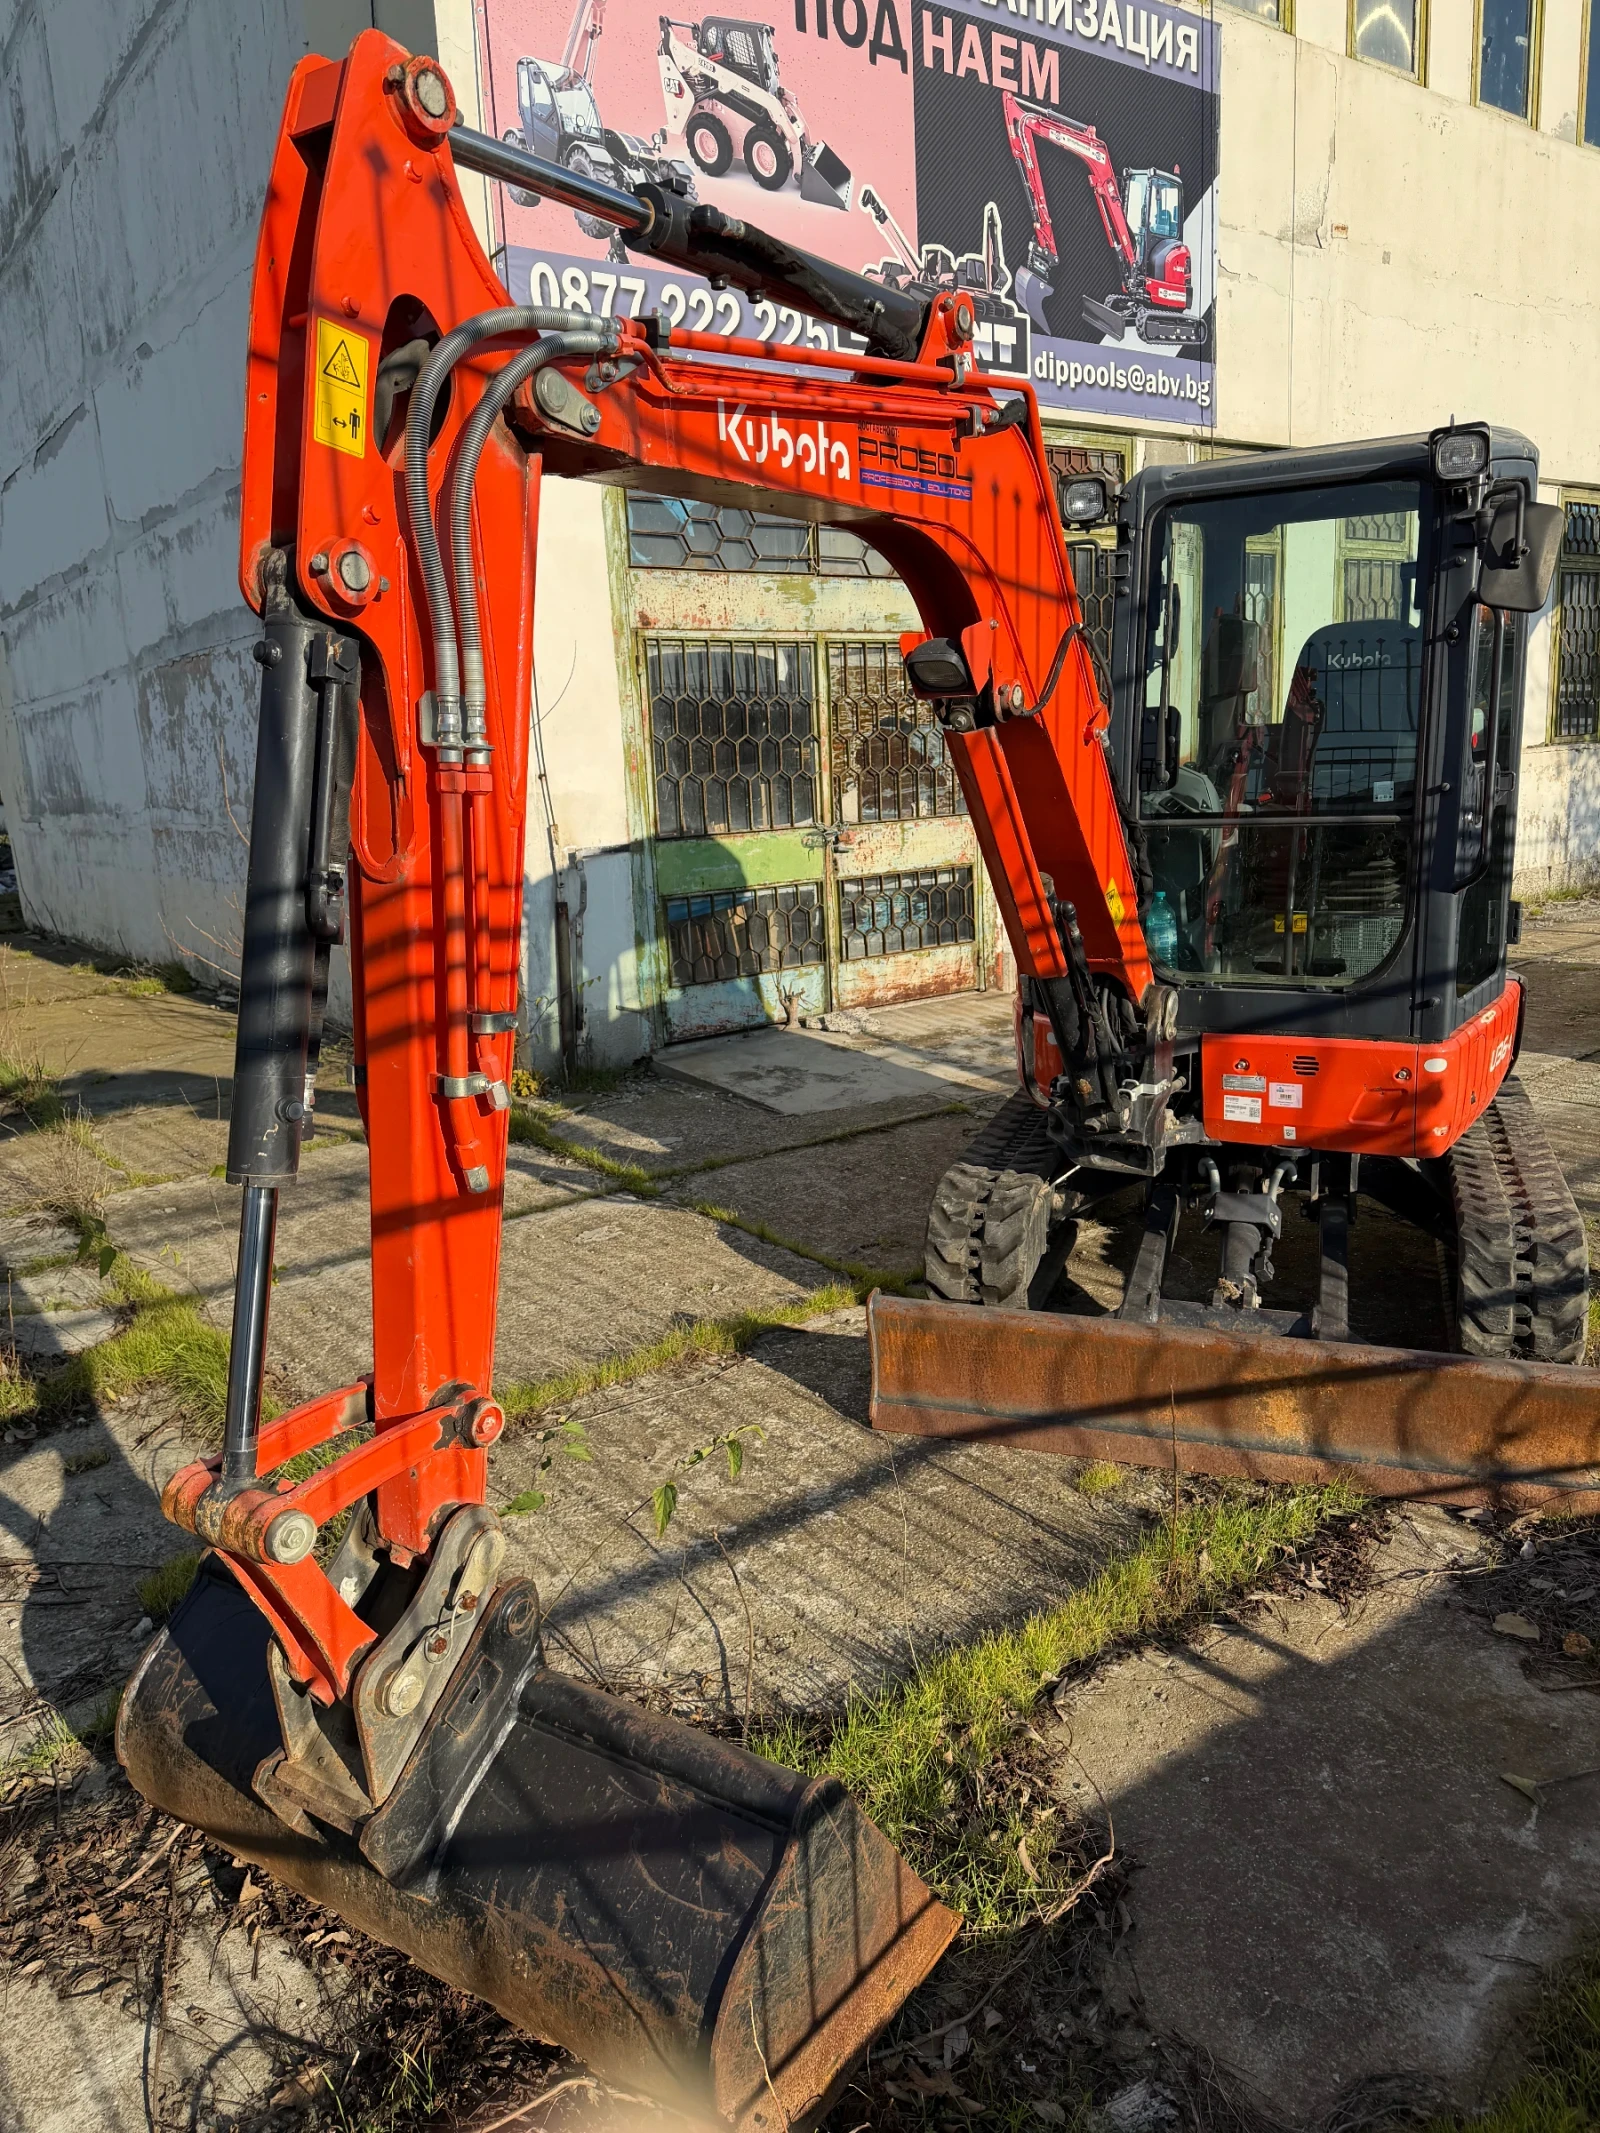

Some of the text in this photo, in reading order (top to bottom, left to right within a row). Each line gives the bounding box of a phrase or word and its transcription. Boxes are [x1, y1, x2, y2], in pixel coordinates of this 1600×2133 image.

[921, 9, 1061, 105] НАЕМ
[977, 0, 1199, 73] ИЗАЦИЯ
[530, 261, 830, 352] 0877 222 225
[1033, 350, 1211, 406] dippools@abv.bg
[717, 397, 851, 481] Kubota
[857, 435, 973, 483] PROSOL
[860, 472, 971, 498] PROFESSIONAL SOLUTIONS
[1327, 650, 1392, 669] Kubota
